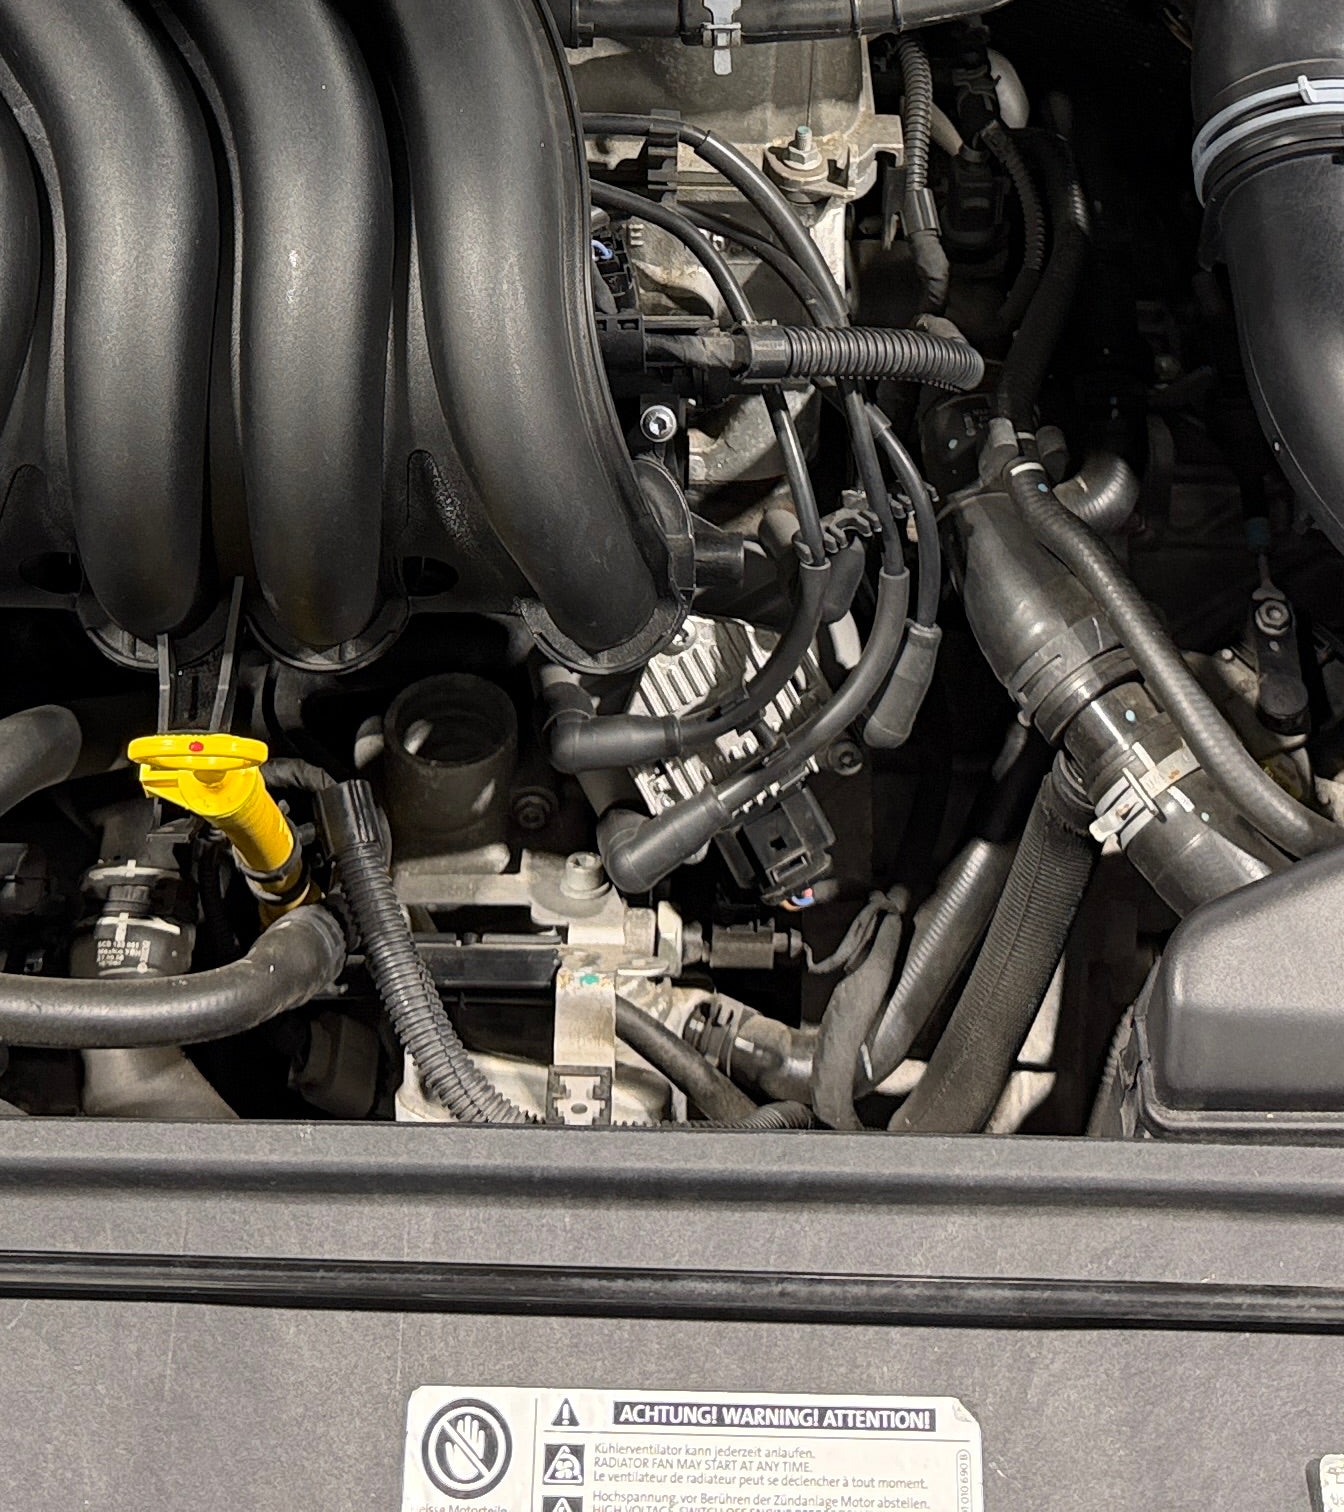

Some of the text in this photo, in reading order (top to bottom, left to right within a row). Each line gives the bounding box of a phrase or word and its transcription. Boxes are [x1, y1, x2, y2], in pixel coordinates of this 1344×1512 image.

[619, 1404, 930, 1430] ACHTUNG! WARNING! ATTENTION!
[594, 1443, 682, 1456] Kühlerventilator
[685, 1443, 712, 1457] kann
[714, 1445, 762, 1461] jederzeit
[594, 1457, 813, 1473] RADIATOR FAN MAY START AT ANY TIME.
[594, 1472, 929, 1489] Le ventilateur de radiateur peut se déclencher à tout moment.
[680, 1494, 698, 1503] vor
[700, 1492, 750, 1504] Berühren
[753, 1494, 772, 1505] der
[774, 1495, 838, 1510] Zündanlage
[840, 1496, 875, 1508] Motor
[877, 1497, 930, 1509] abstellen.
